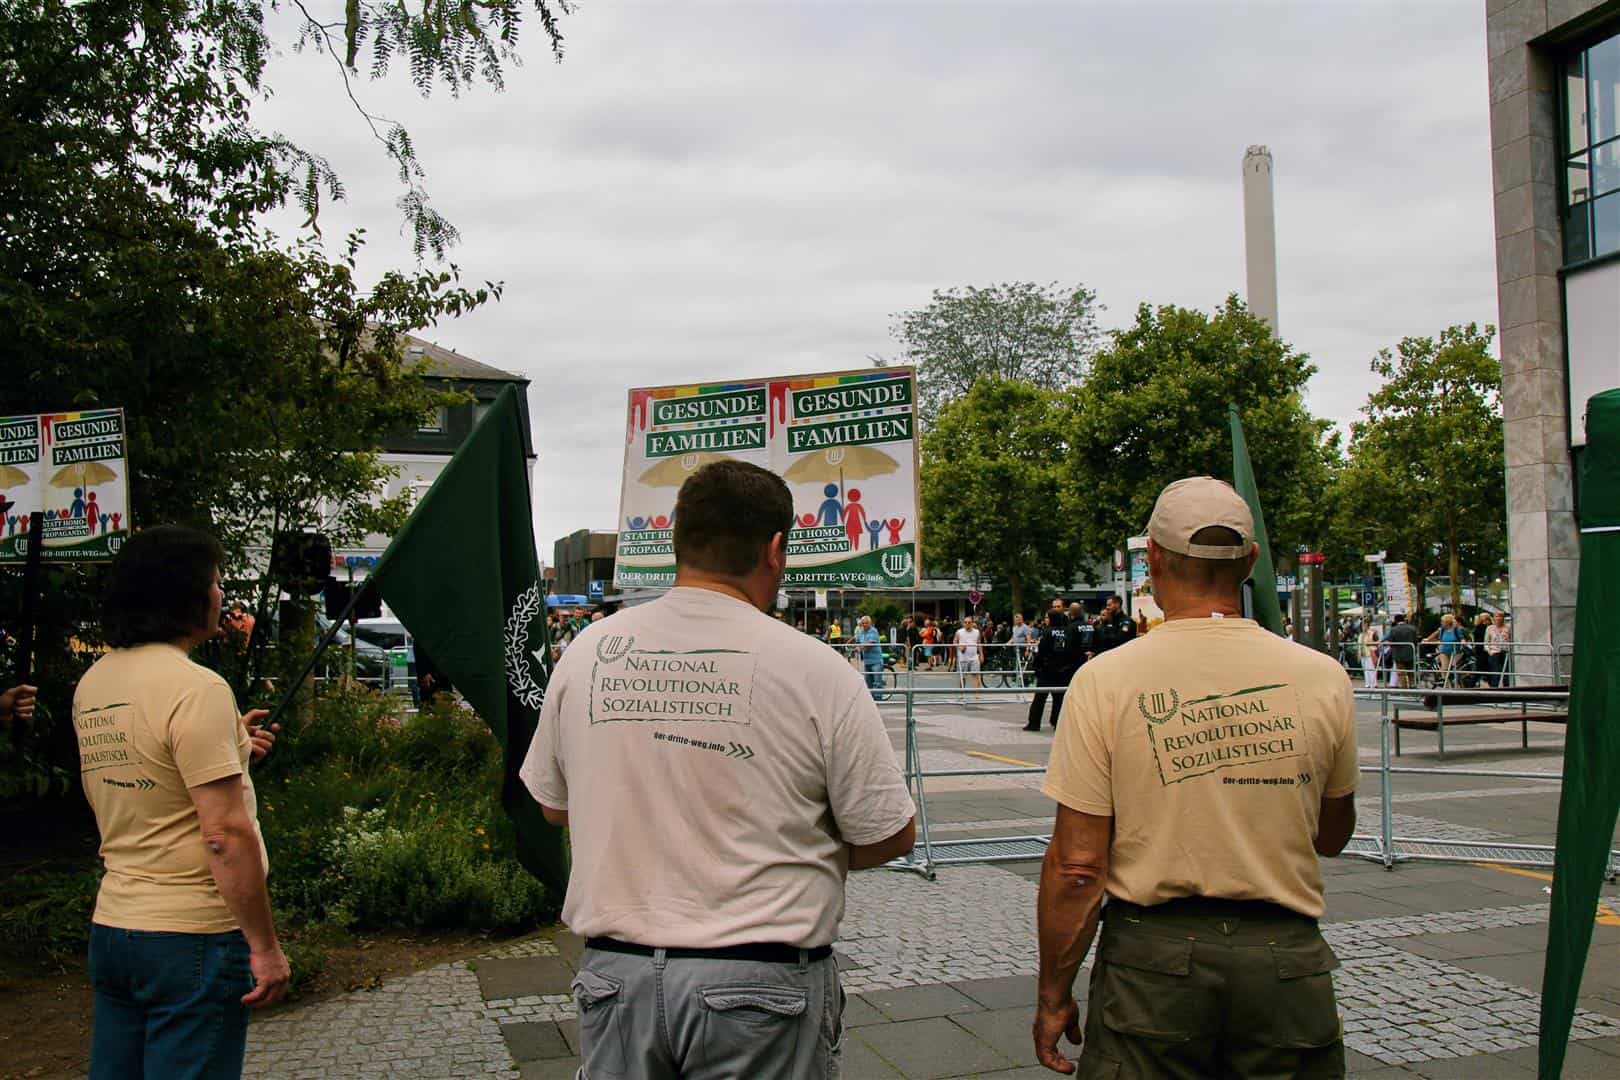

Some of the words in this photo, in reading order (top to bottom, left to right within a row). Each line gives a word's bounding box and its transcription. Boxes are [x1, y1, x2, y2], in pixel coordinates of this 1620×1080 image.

[657, 394, 761, 421] GESUNDE
[798, 384, 906, 414] GESUNDE
[0, 424, 36, 441] UNDE
[57, 419, 119, 437] GESUNDE
[792, 418, 910, 448] FAMILIEN
[650, 428, 763, 455] FAMILIEN
[0, 447, 37, 463] ILIEN
[55, 444, 122, 463] FAMILIEN
[624, 531, 656, 541] STATT
[658, 531, 674, 540] HO
[807, 528, 843, 538] HOMO-
[623, 544, 674, 554] PROPAGA
[787, 542, 849, 553] OPAGANDA!
[624, 657, 719, 674] NATIONAL
[600, 677, 741, 696] REVOLUTIONÄR
[602, 697, 733, 717] SOZIALISTISCH
[1181, 699, 1270, 727] NATIONAL
[81, 731, 128, 748] OLUTIONÄR
[1163, 715, 1296, 753] REVOLUTIONÄR
[82, 749, 128, 764] ZIALISTISCH
[1171, 738, 1295, 773] SOZIALISTISCH
